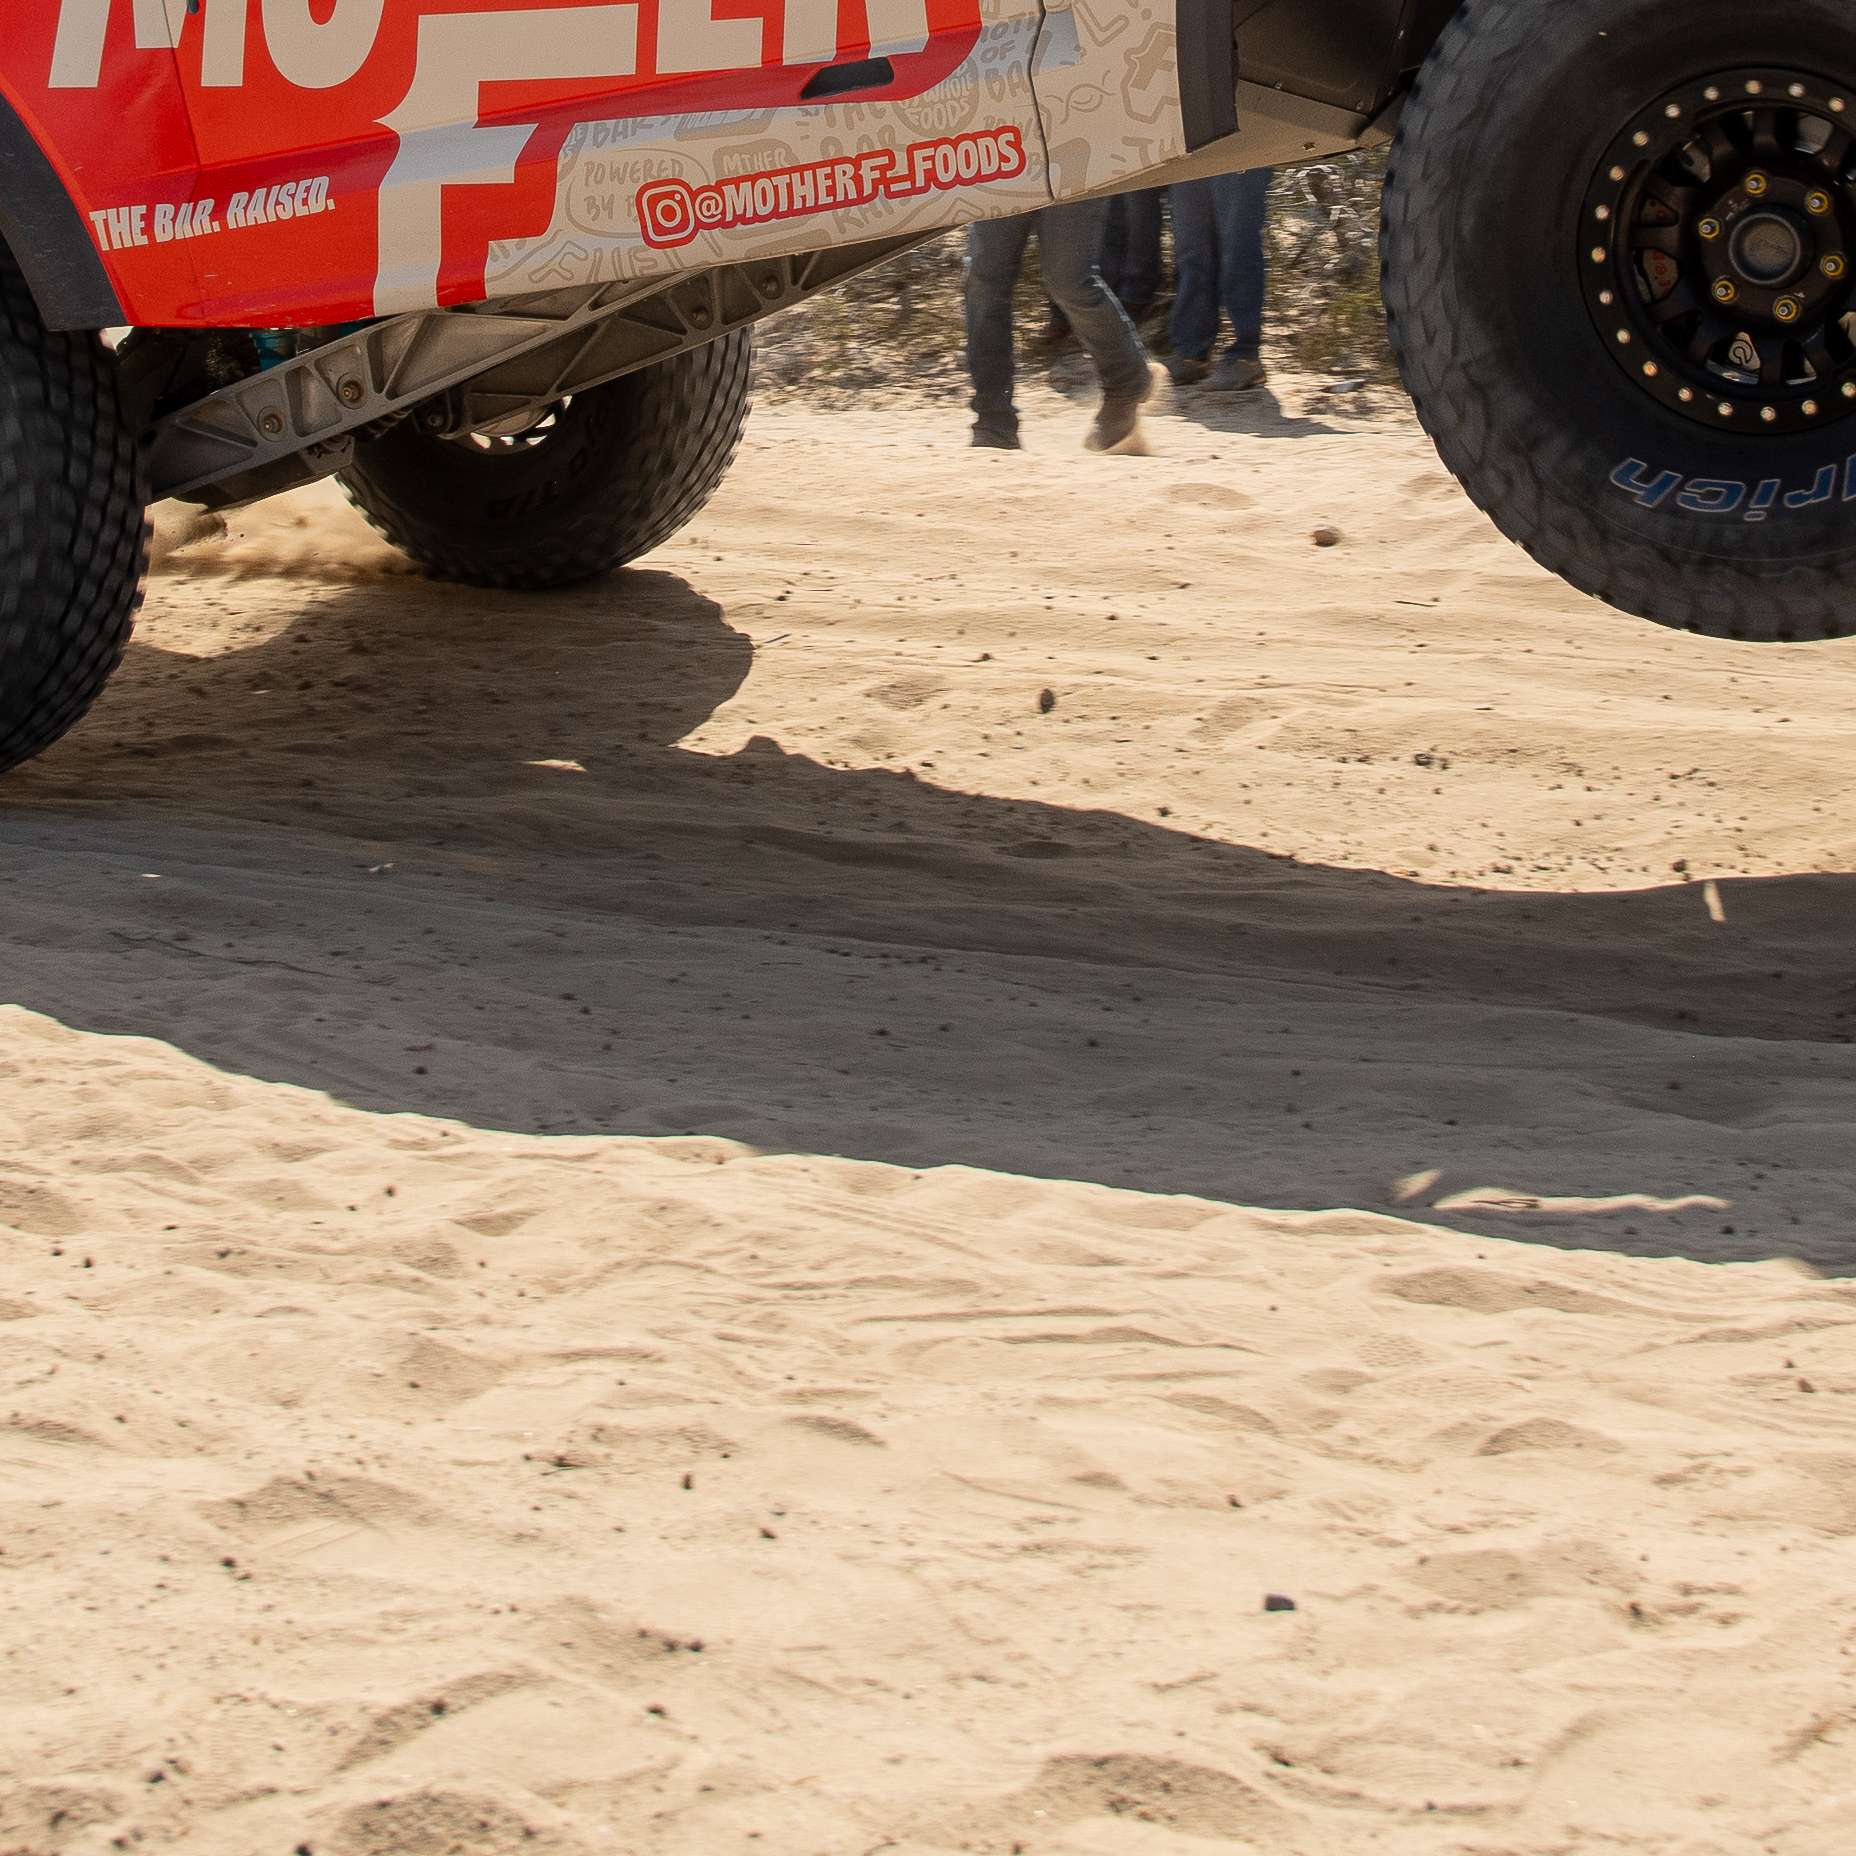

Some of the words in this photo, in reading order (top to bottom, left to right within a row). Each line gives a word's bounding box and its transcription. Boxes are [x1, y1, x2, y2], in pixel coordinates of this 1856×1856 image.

[88, 204, 149, 252] THE
[153, 198, 221, 243] BAR.
[226, 175, 336, 230] RAISED.
